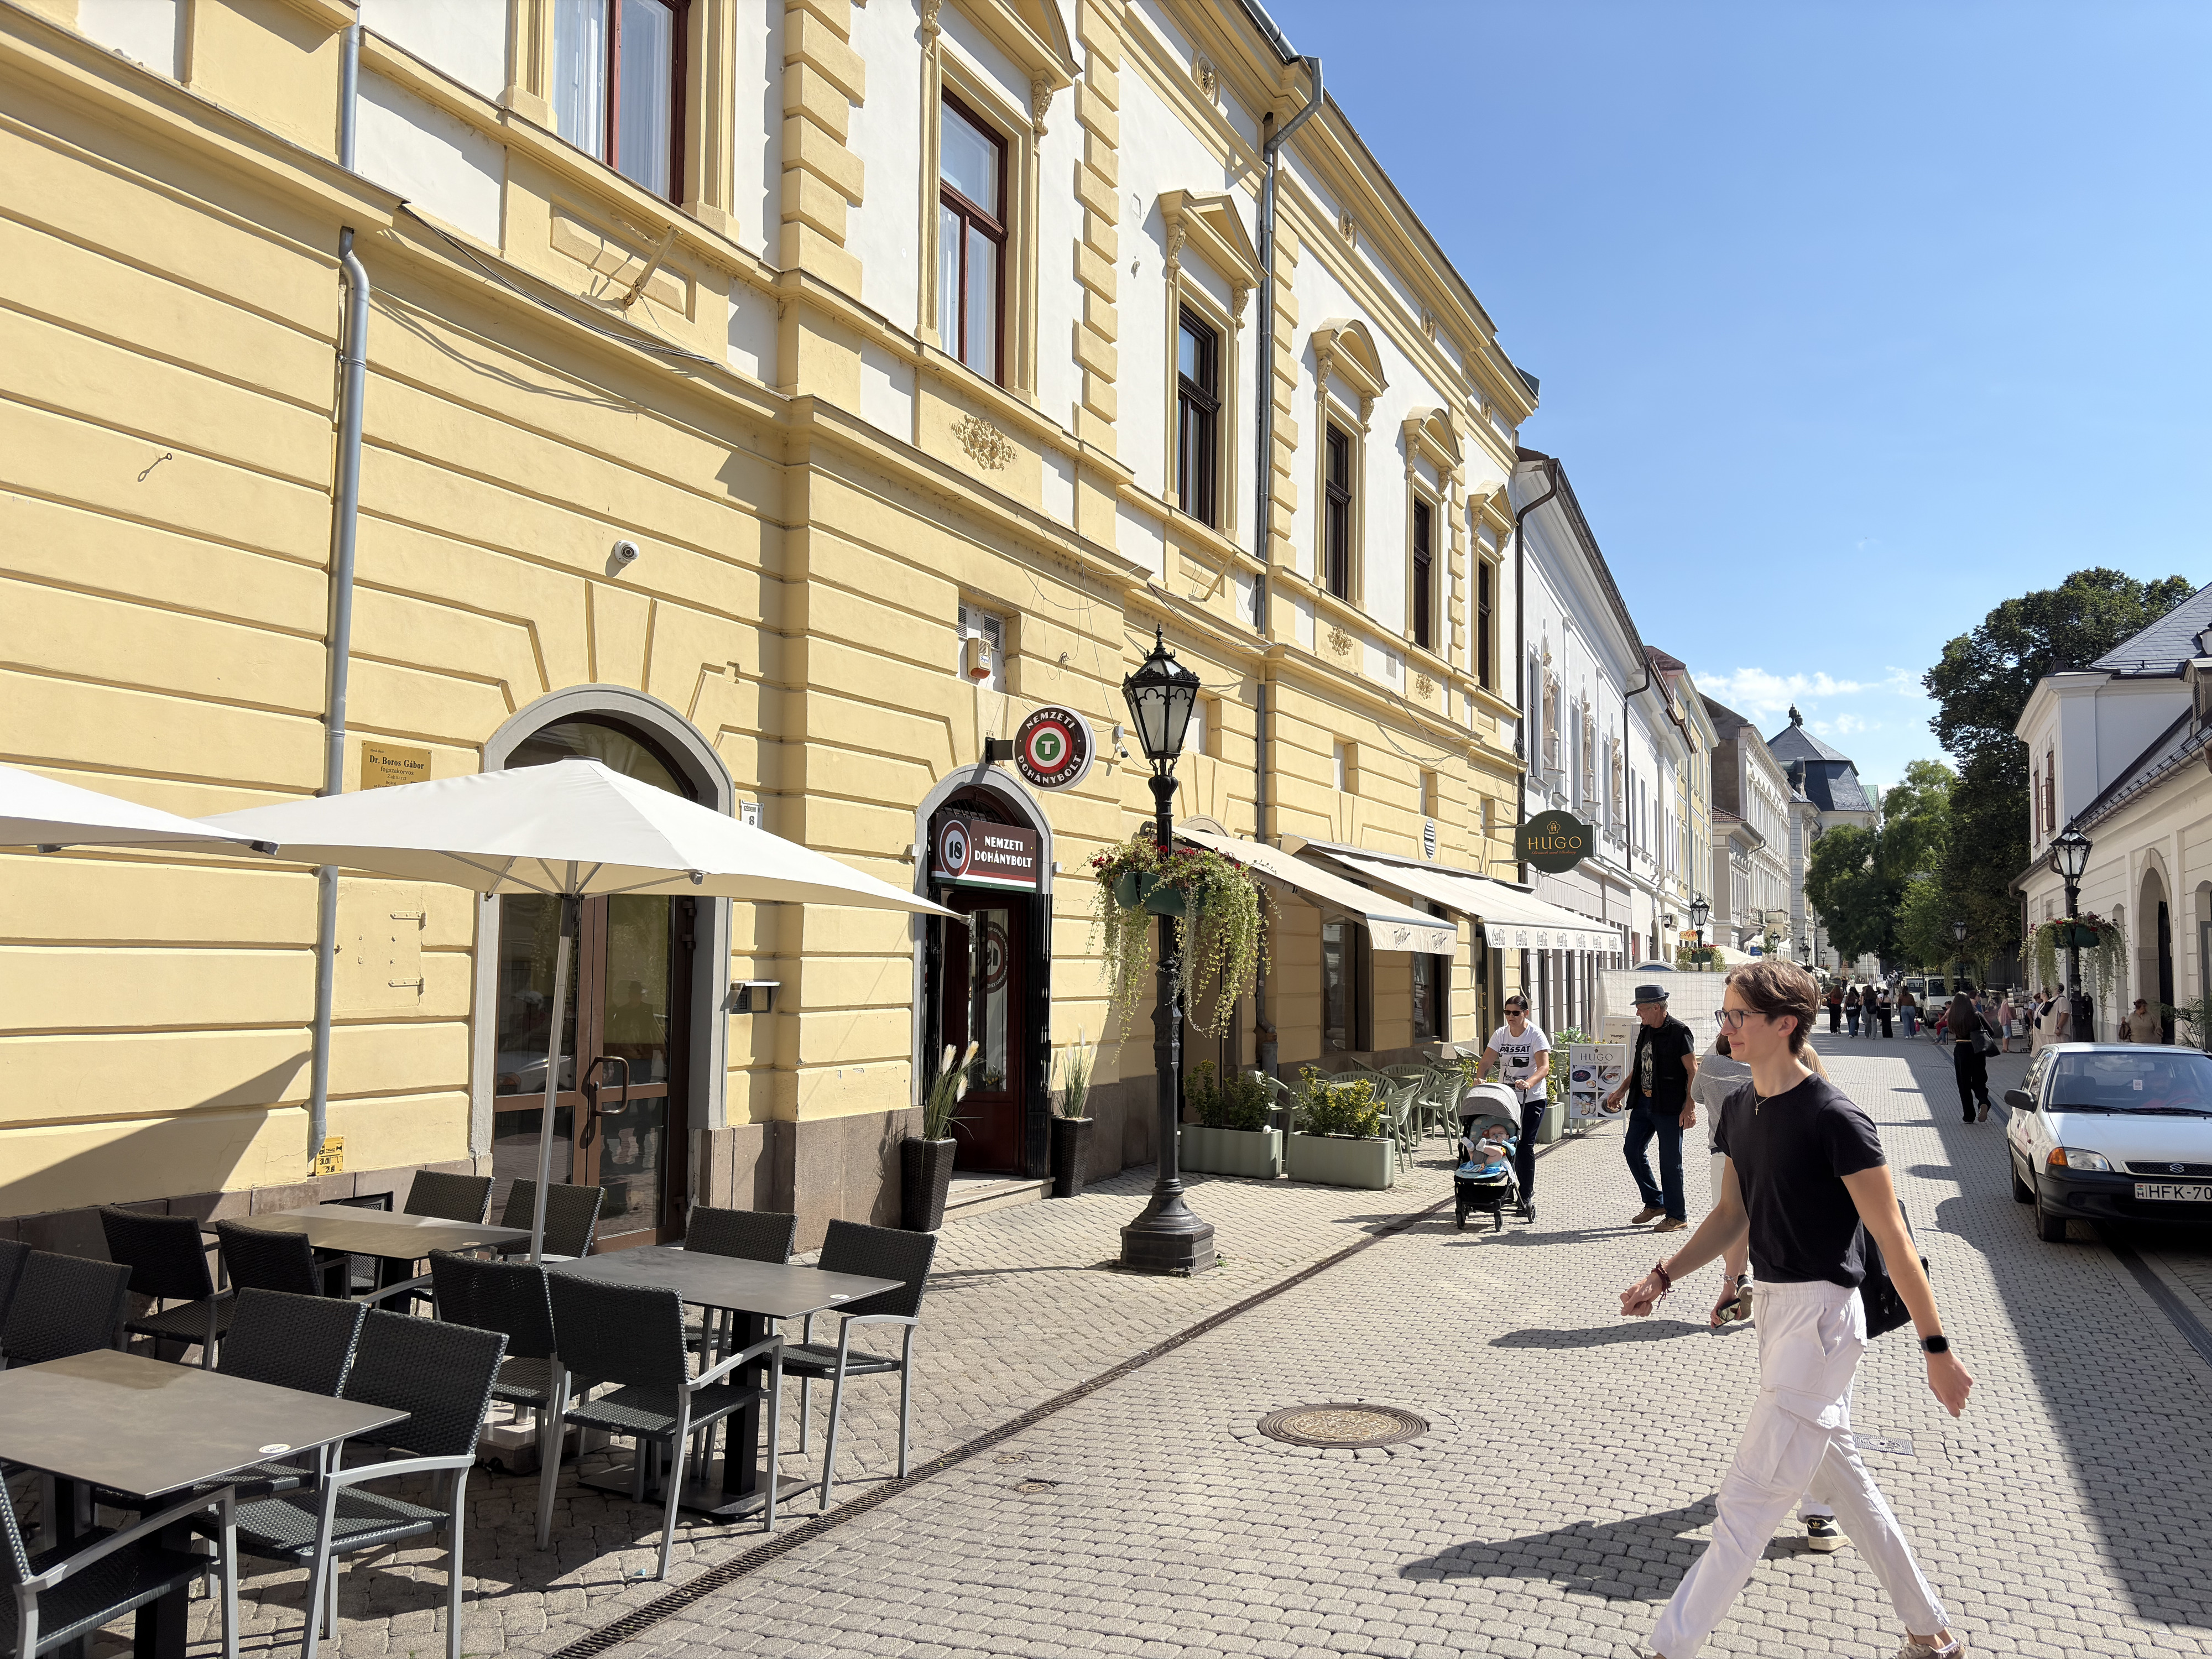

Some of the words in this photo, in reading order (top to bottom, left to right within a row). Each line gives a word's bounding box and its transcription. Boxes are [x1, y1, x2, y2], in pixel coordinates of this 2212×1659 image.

[1026, 711, 1075, 729] NEMZETI
[1041, 740, 1055, 754] T
[369, 755, 380, 764] Dr.
[382, 757, 401, 766] Boros
[404, 759, 424, 769] Gábor
[1018, 754, 1082, 784] DOHÁNYBOLT
[380, 766, 414, 775] fogszakorvos
[749, 816, 755, 826] 8
[949, 840, 963, 859] 18
[984, 836, 1023, 852] NEMZETI
[1527, 836, 1582, 850] HUGO
[974, 850, 1032, 868] DOHÁNYBOLT
